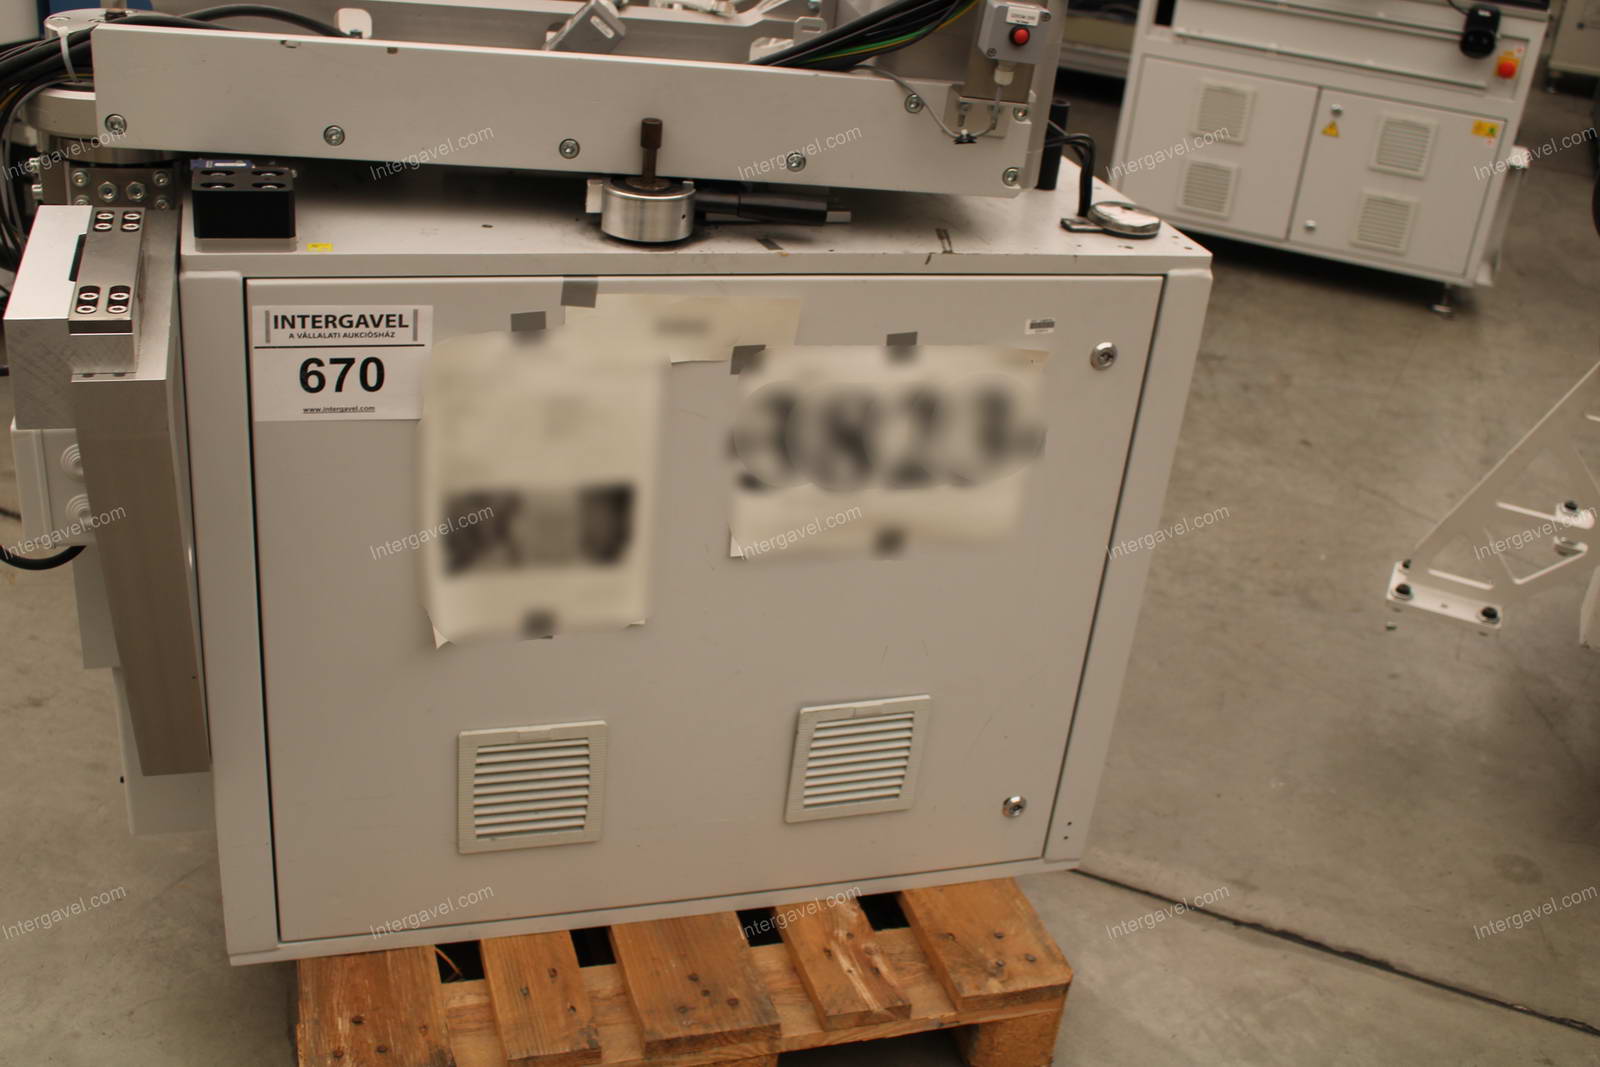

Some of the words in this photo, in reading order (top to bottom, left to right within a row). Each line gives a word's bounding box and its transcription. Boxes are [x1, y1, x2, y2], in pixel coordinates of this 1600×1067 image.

[273, 314, 409, 329] INTERGAVEL
[299, 357, 385, 393] 670
[303, 405, 375, 414] www.intergavel.com
